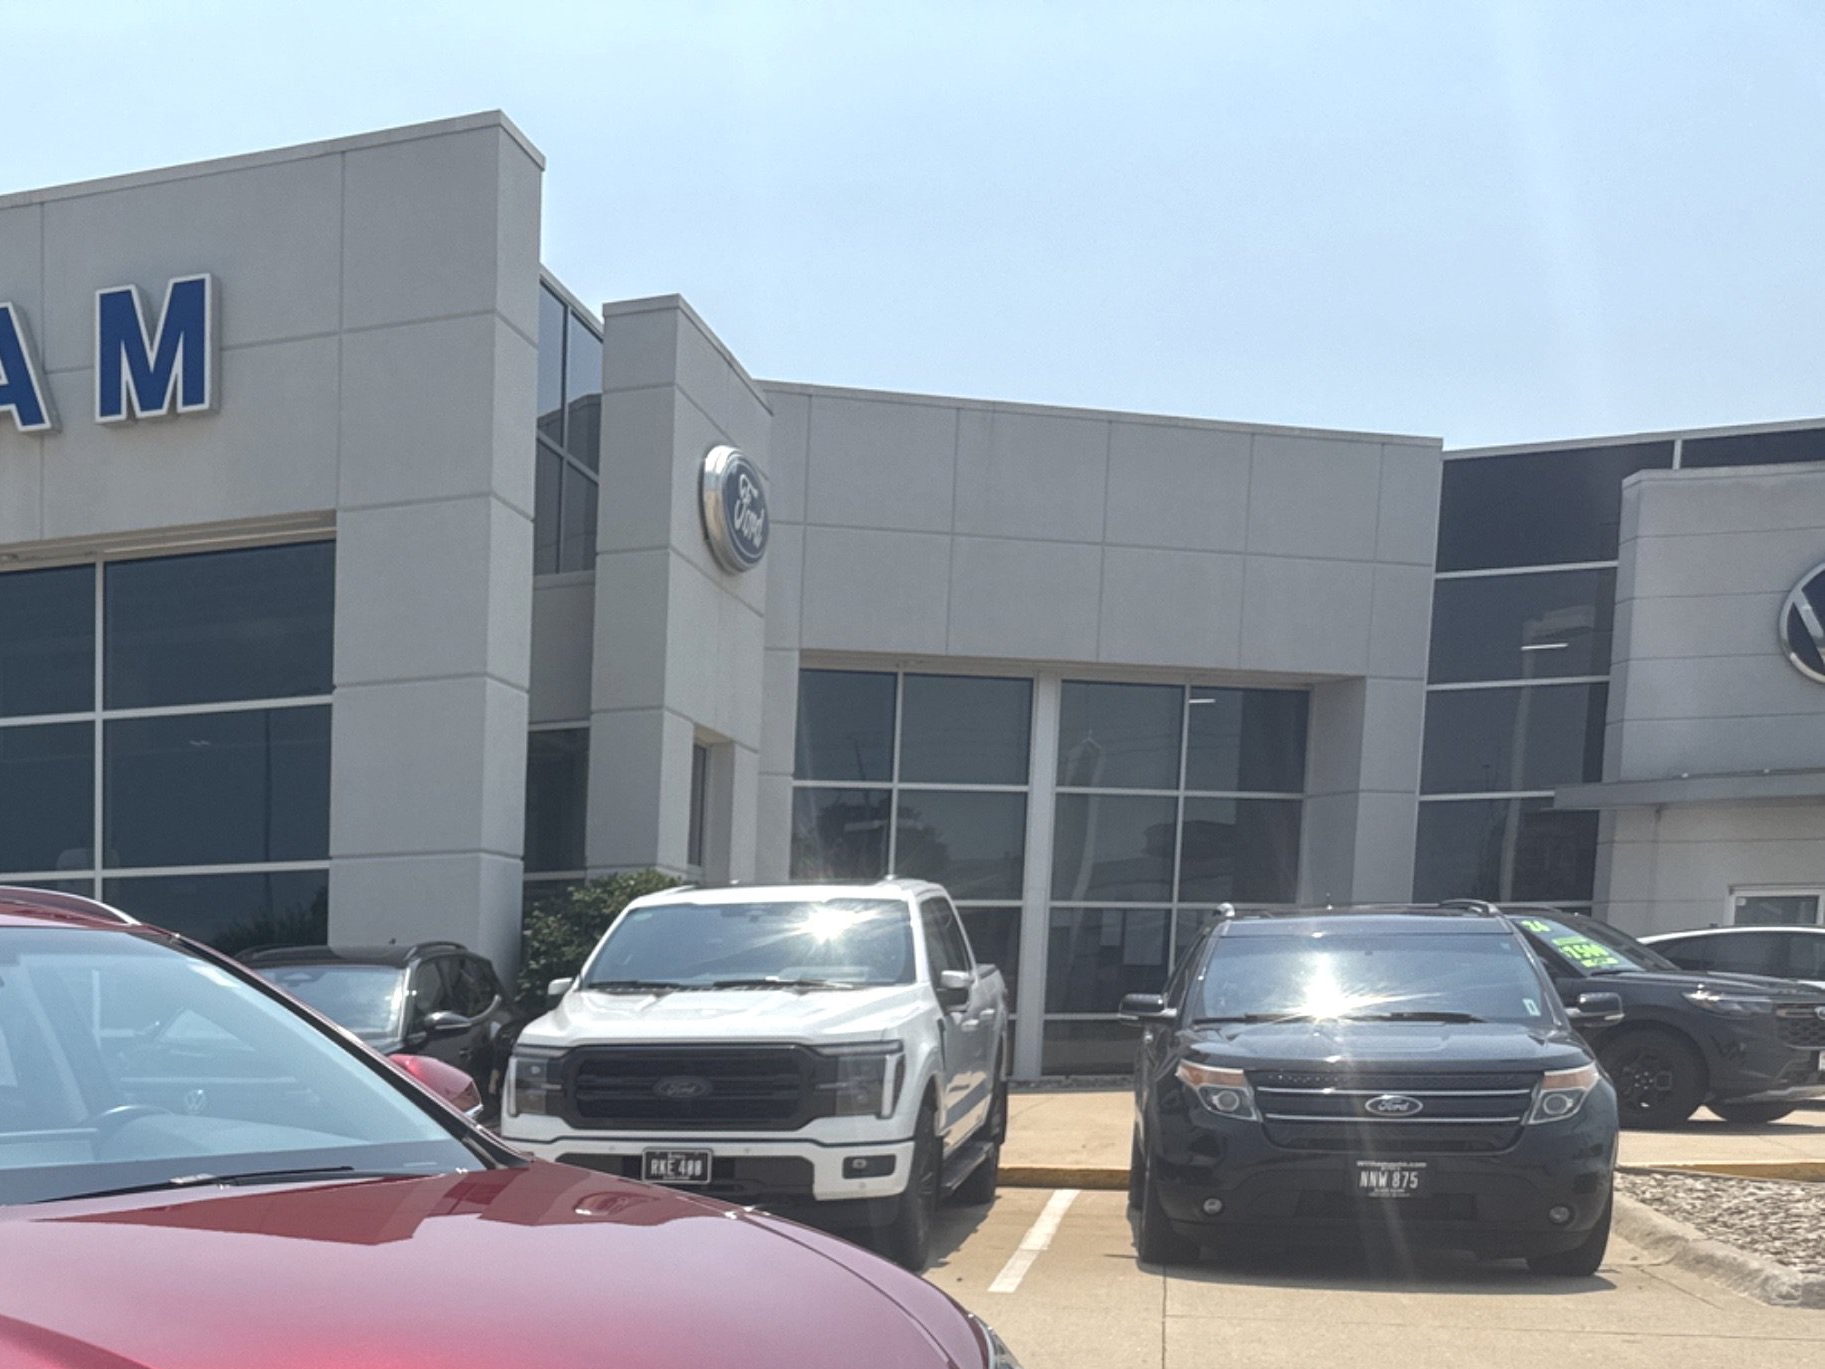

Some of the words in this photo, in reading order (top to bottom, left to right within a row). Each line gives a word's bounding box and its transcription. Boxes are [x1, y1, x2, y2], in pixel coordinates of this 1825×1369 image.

[734, 474, 765, 548] Ford
[1359, 1171, 1388, 1188] NNW
[1392, 1171, 1419, 1189] 875
